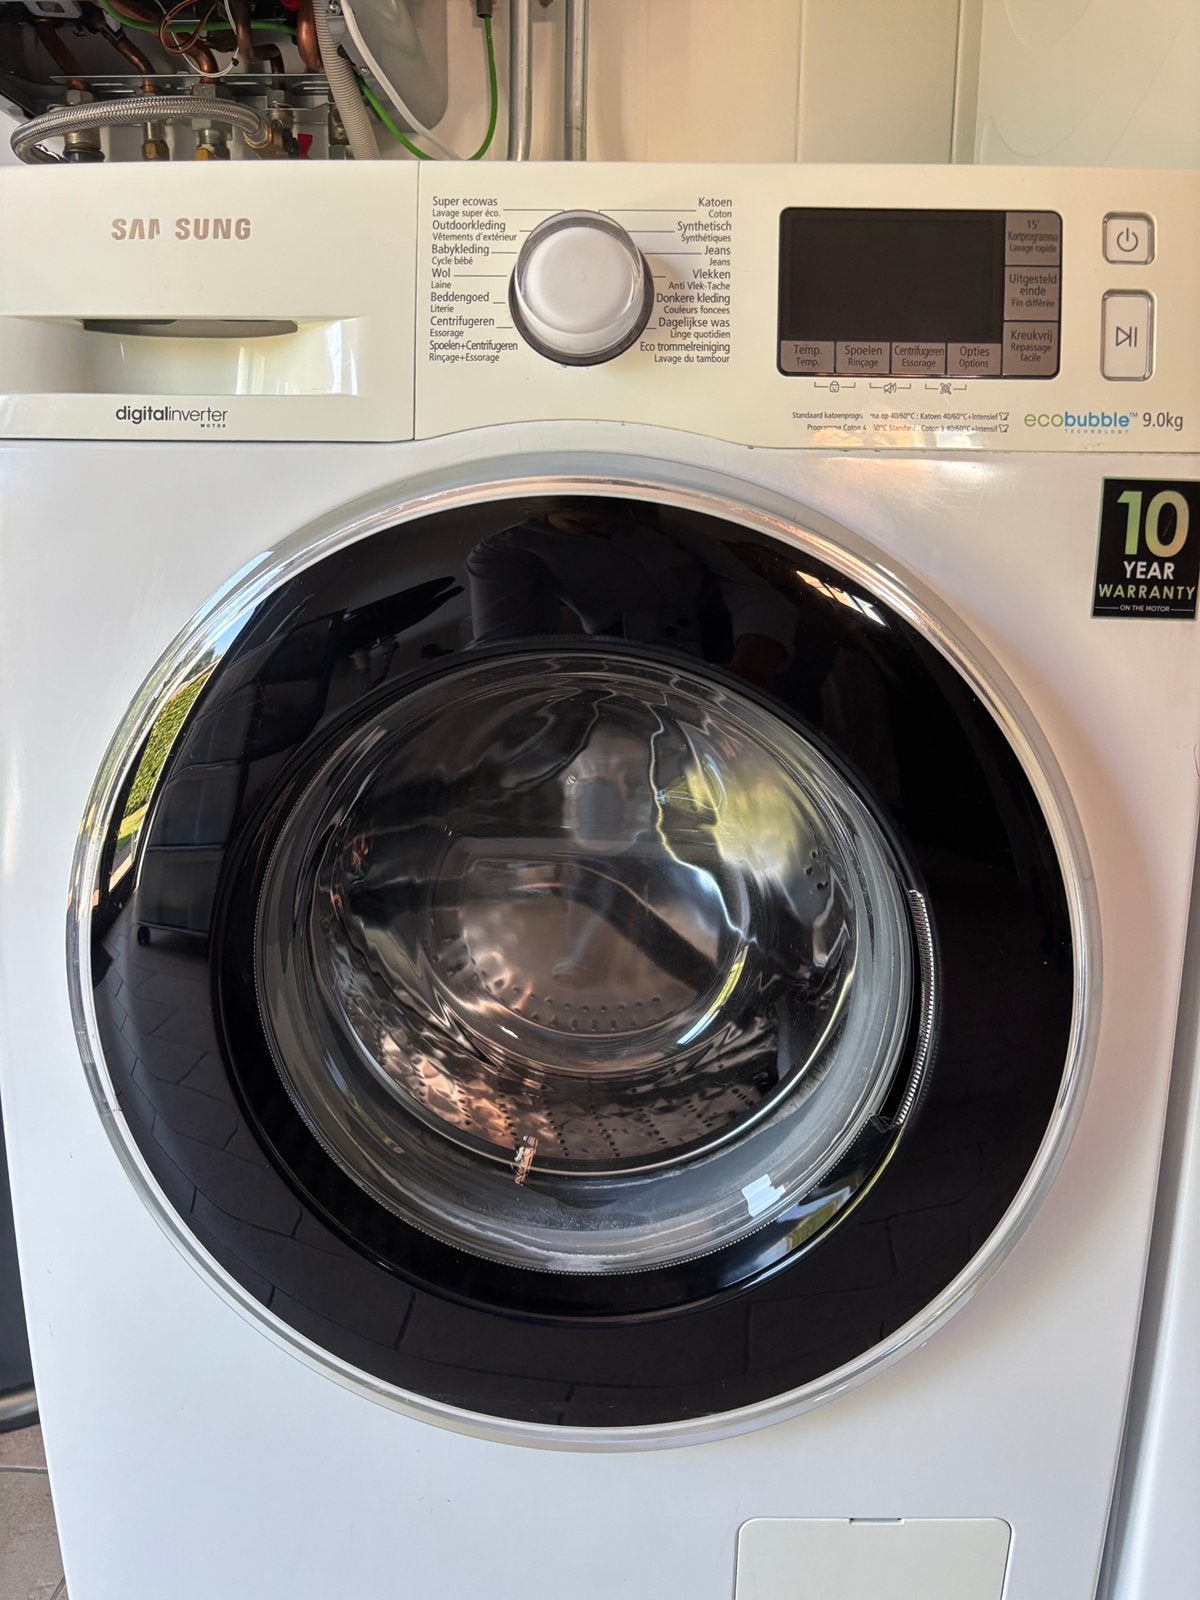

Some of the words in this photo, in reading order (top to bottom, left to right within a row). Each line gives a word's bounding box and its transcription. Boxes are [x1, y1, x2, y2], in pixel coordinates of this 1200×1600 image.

[433, 196, 460, 208] Super
[462, 198, 498, 206] ecowas
[699, 198, 732, 207] Katoen
[432, 209, 459, 217] Lavage
[462, 210, 483, 218] super
[485, 208, 501, 217] éco.
[709, 210, 732, 218] Coton
[432, 220, 506, 232] Outdoorkleding
[677, 221, 732, 233] Synthetisch
[432, 233, 473, 241] Vêtements
[681, 234, 731, 243] Synthétiques
[432, 244, 489, 256] Babykleding
[704, 245, 731, 255] Jeans
[432, 257, 452, 266] Cycle
[454, 256, 473, 265] bébé
[709, 258, 731, 266] Jeans
[432, 268, 451, 278] Wol
[693, 269, 731, 279] Vlekken
[431, 281, 451, 289] Laine
[1009, 273, 1057, 287] Uitgesteld
[668, 282, 685, 290] Anti
[688, 282, 730, 290] Vlek-Tache
[1020, 285, 1046, 296] einde
[431, 292, 489, 304] Beddengoed
[656, 293, 694, 303] Donkere
[697, 293, 730, 306] kleding
[1012, 299, 1024, 308] Fin
[1025, 298, 1055, 308] différée
[664, 306, 698, 314] Couleurs
[700, 306, 730, 314] foncees
[430, 316, 494, 328] Centrifugeren
[659, 317, 707, 329] Dagelijkse
[711, 319, 730, 327] was
[430, 329, 464, 338] Essorage
[671, 330, 691, 339] Linge
[694, 330, 730, 339] quotidien
[1011, 330, 1052, 343] Kreukvrij
[429, 340, 518, 352] Spoelen+Centrifugeren
[640, 342, 655, 351] Eco
[658, 342, 730, 354] trommelreiniging
[794, 345, 822, 356] Temp.
[845, 345, 882, 356] Spoelen
[894, 345, 944, 357] Centrifugeren
[1011, 343, 1052, 353] Repassage
[960, 346, 990, 357] Opties
[429, 353, 500, 362] Rinçage+Essorage
[655, 355, 682, 363] Lavage
[684, 354, 694, 363] du
[697, 354, 729, 363] tambour
[796, 357, 819, 367] Temp.
[1020, 353, 1041, 362] facile
[848, 358, 879, 368] Rinçage
[902, 359, 936, 369] Essorage
[959, 359, 988, 369] Options
[116, 406, 228, 424] digitalinverter
[1143, 412, 1183, 431] 9.0kg
[1117, 490, 1189, 557] 10
[1124, 561, 1174, 579] YEAR
[1099, 584, 1195, 600] WARRANTY
